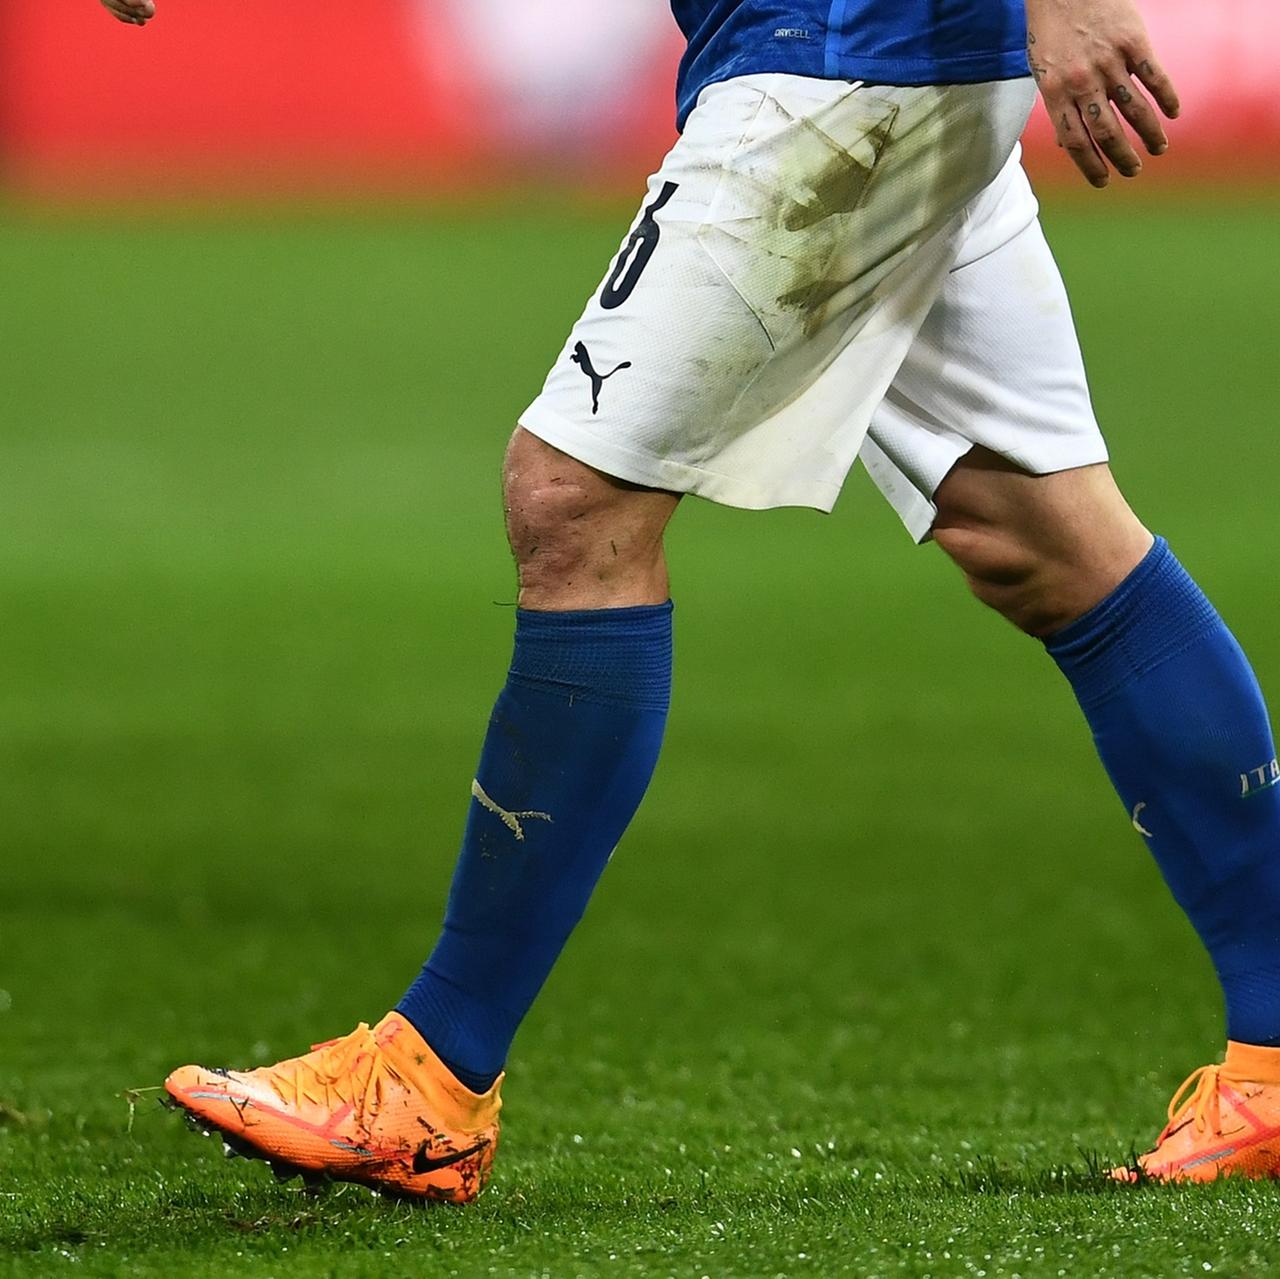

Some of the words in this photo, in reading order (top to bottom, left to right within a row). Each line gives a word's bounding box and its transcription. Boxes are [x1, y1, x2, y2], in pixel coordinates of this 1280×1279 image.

[773, 27, 811, 40] DRYCELL
[600, 180, 680, 310] 6
[1240, 758, 1280, 794] ITA
